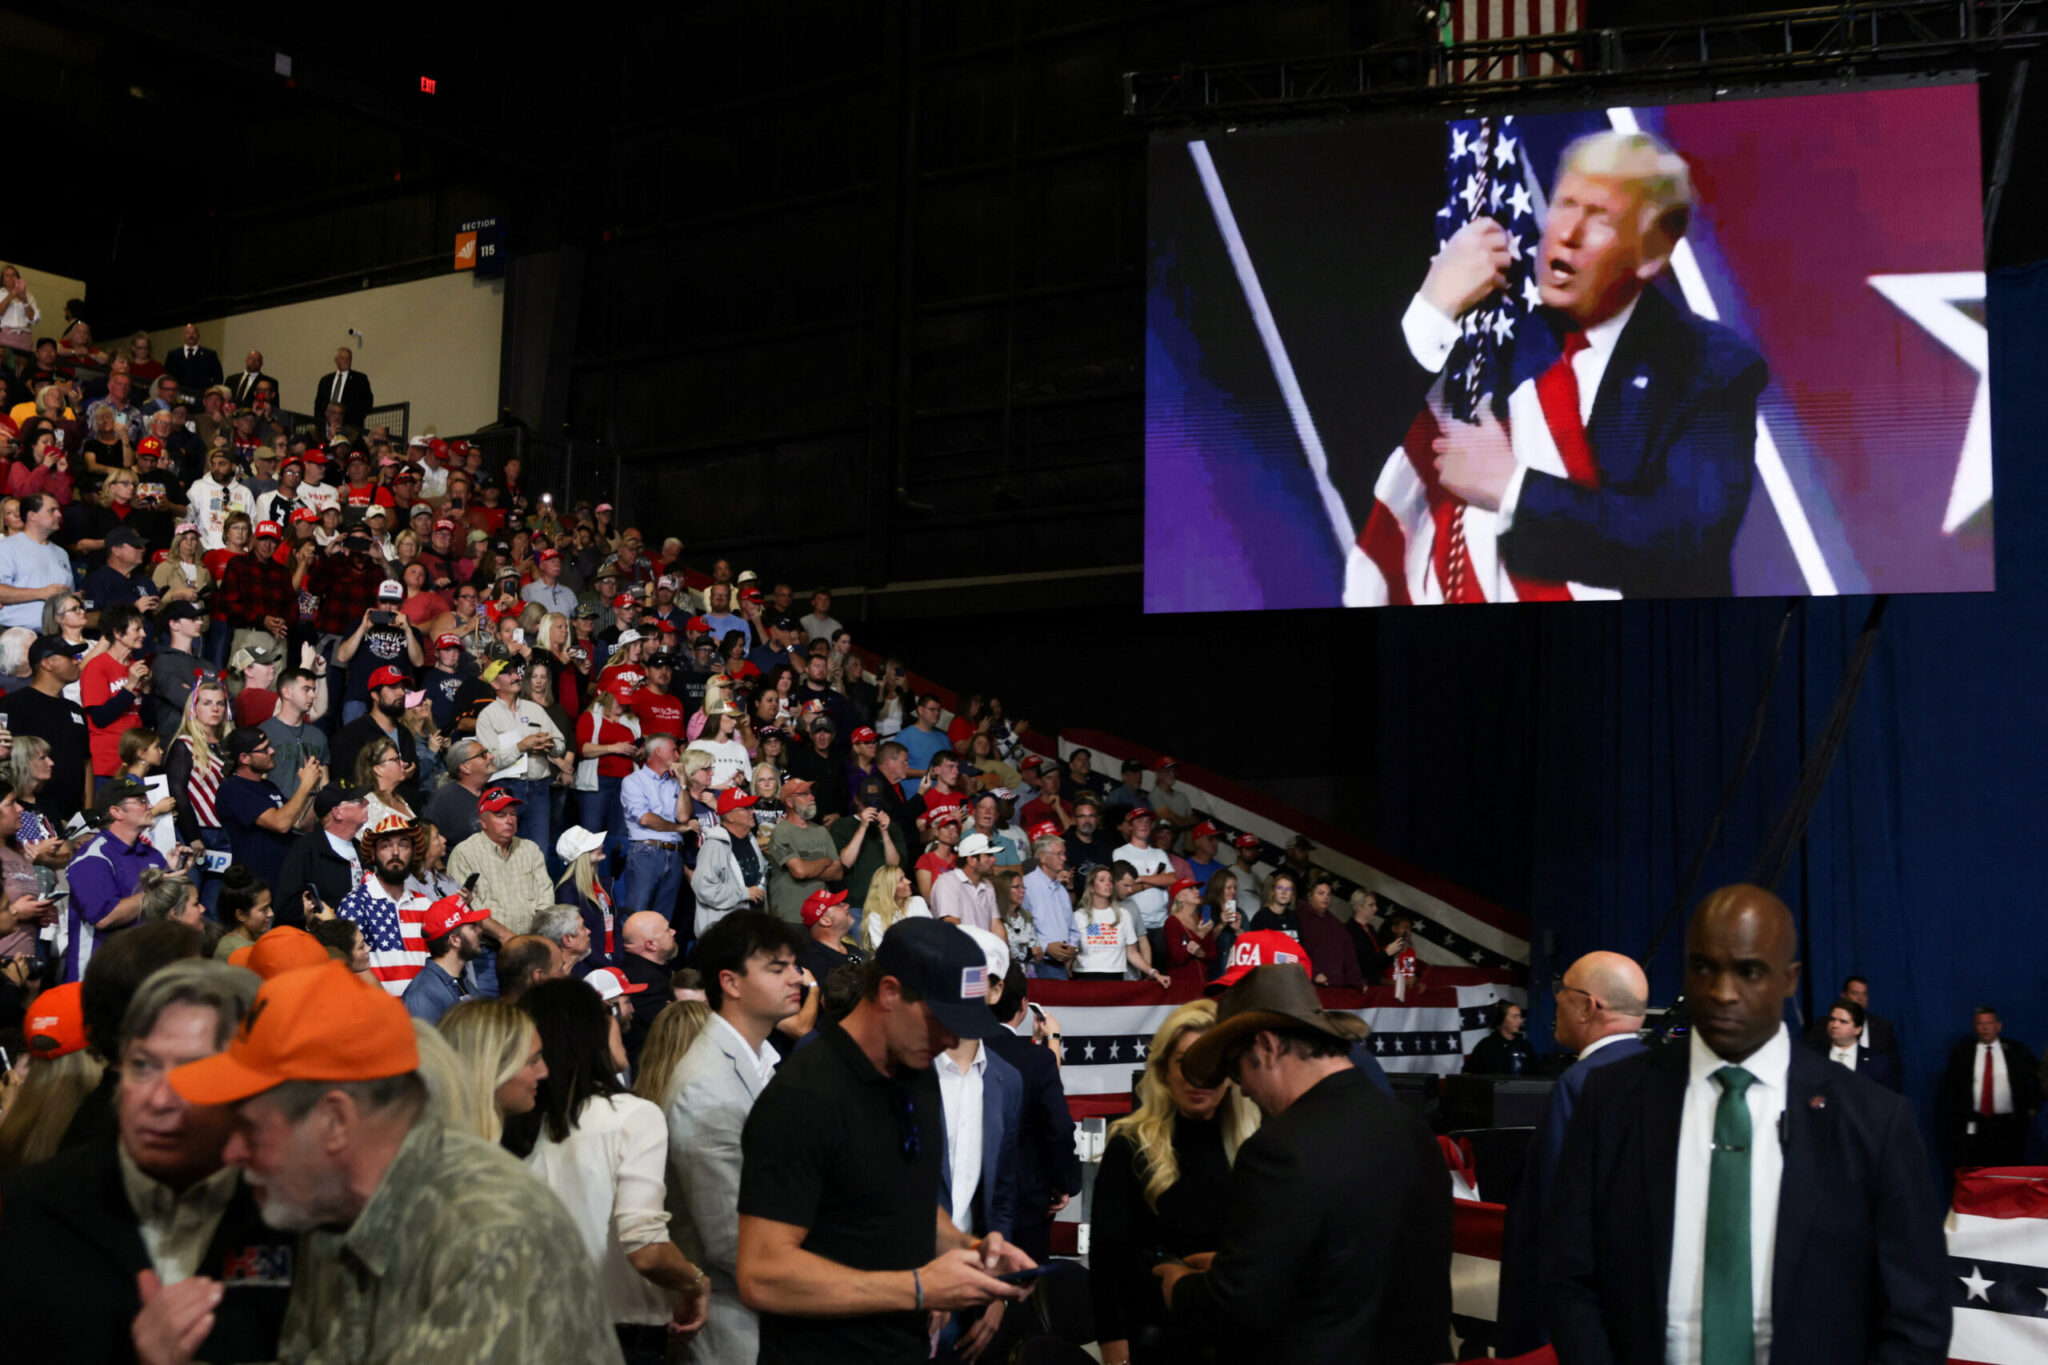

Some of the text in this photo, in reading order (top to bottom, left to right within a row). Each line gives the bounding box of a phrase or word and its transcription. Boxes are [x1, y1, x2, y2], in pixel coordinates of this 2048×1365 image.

[420, 76, 437, 95] EXIT
[462, 218, 496, 231] SECTION
[481, 245, 495, 257] 115
[144, 440, 159, 449] 47
[260, 524, 277, 533] MAGA
[364, 630, 408, 649] AMERICA
[444, 912, 461, 928] 45-47
[1226, 942, 1261, 968] AGA
